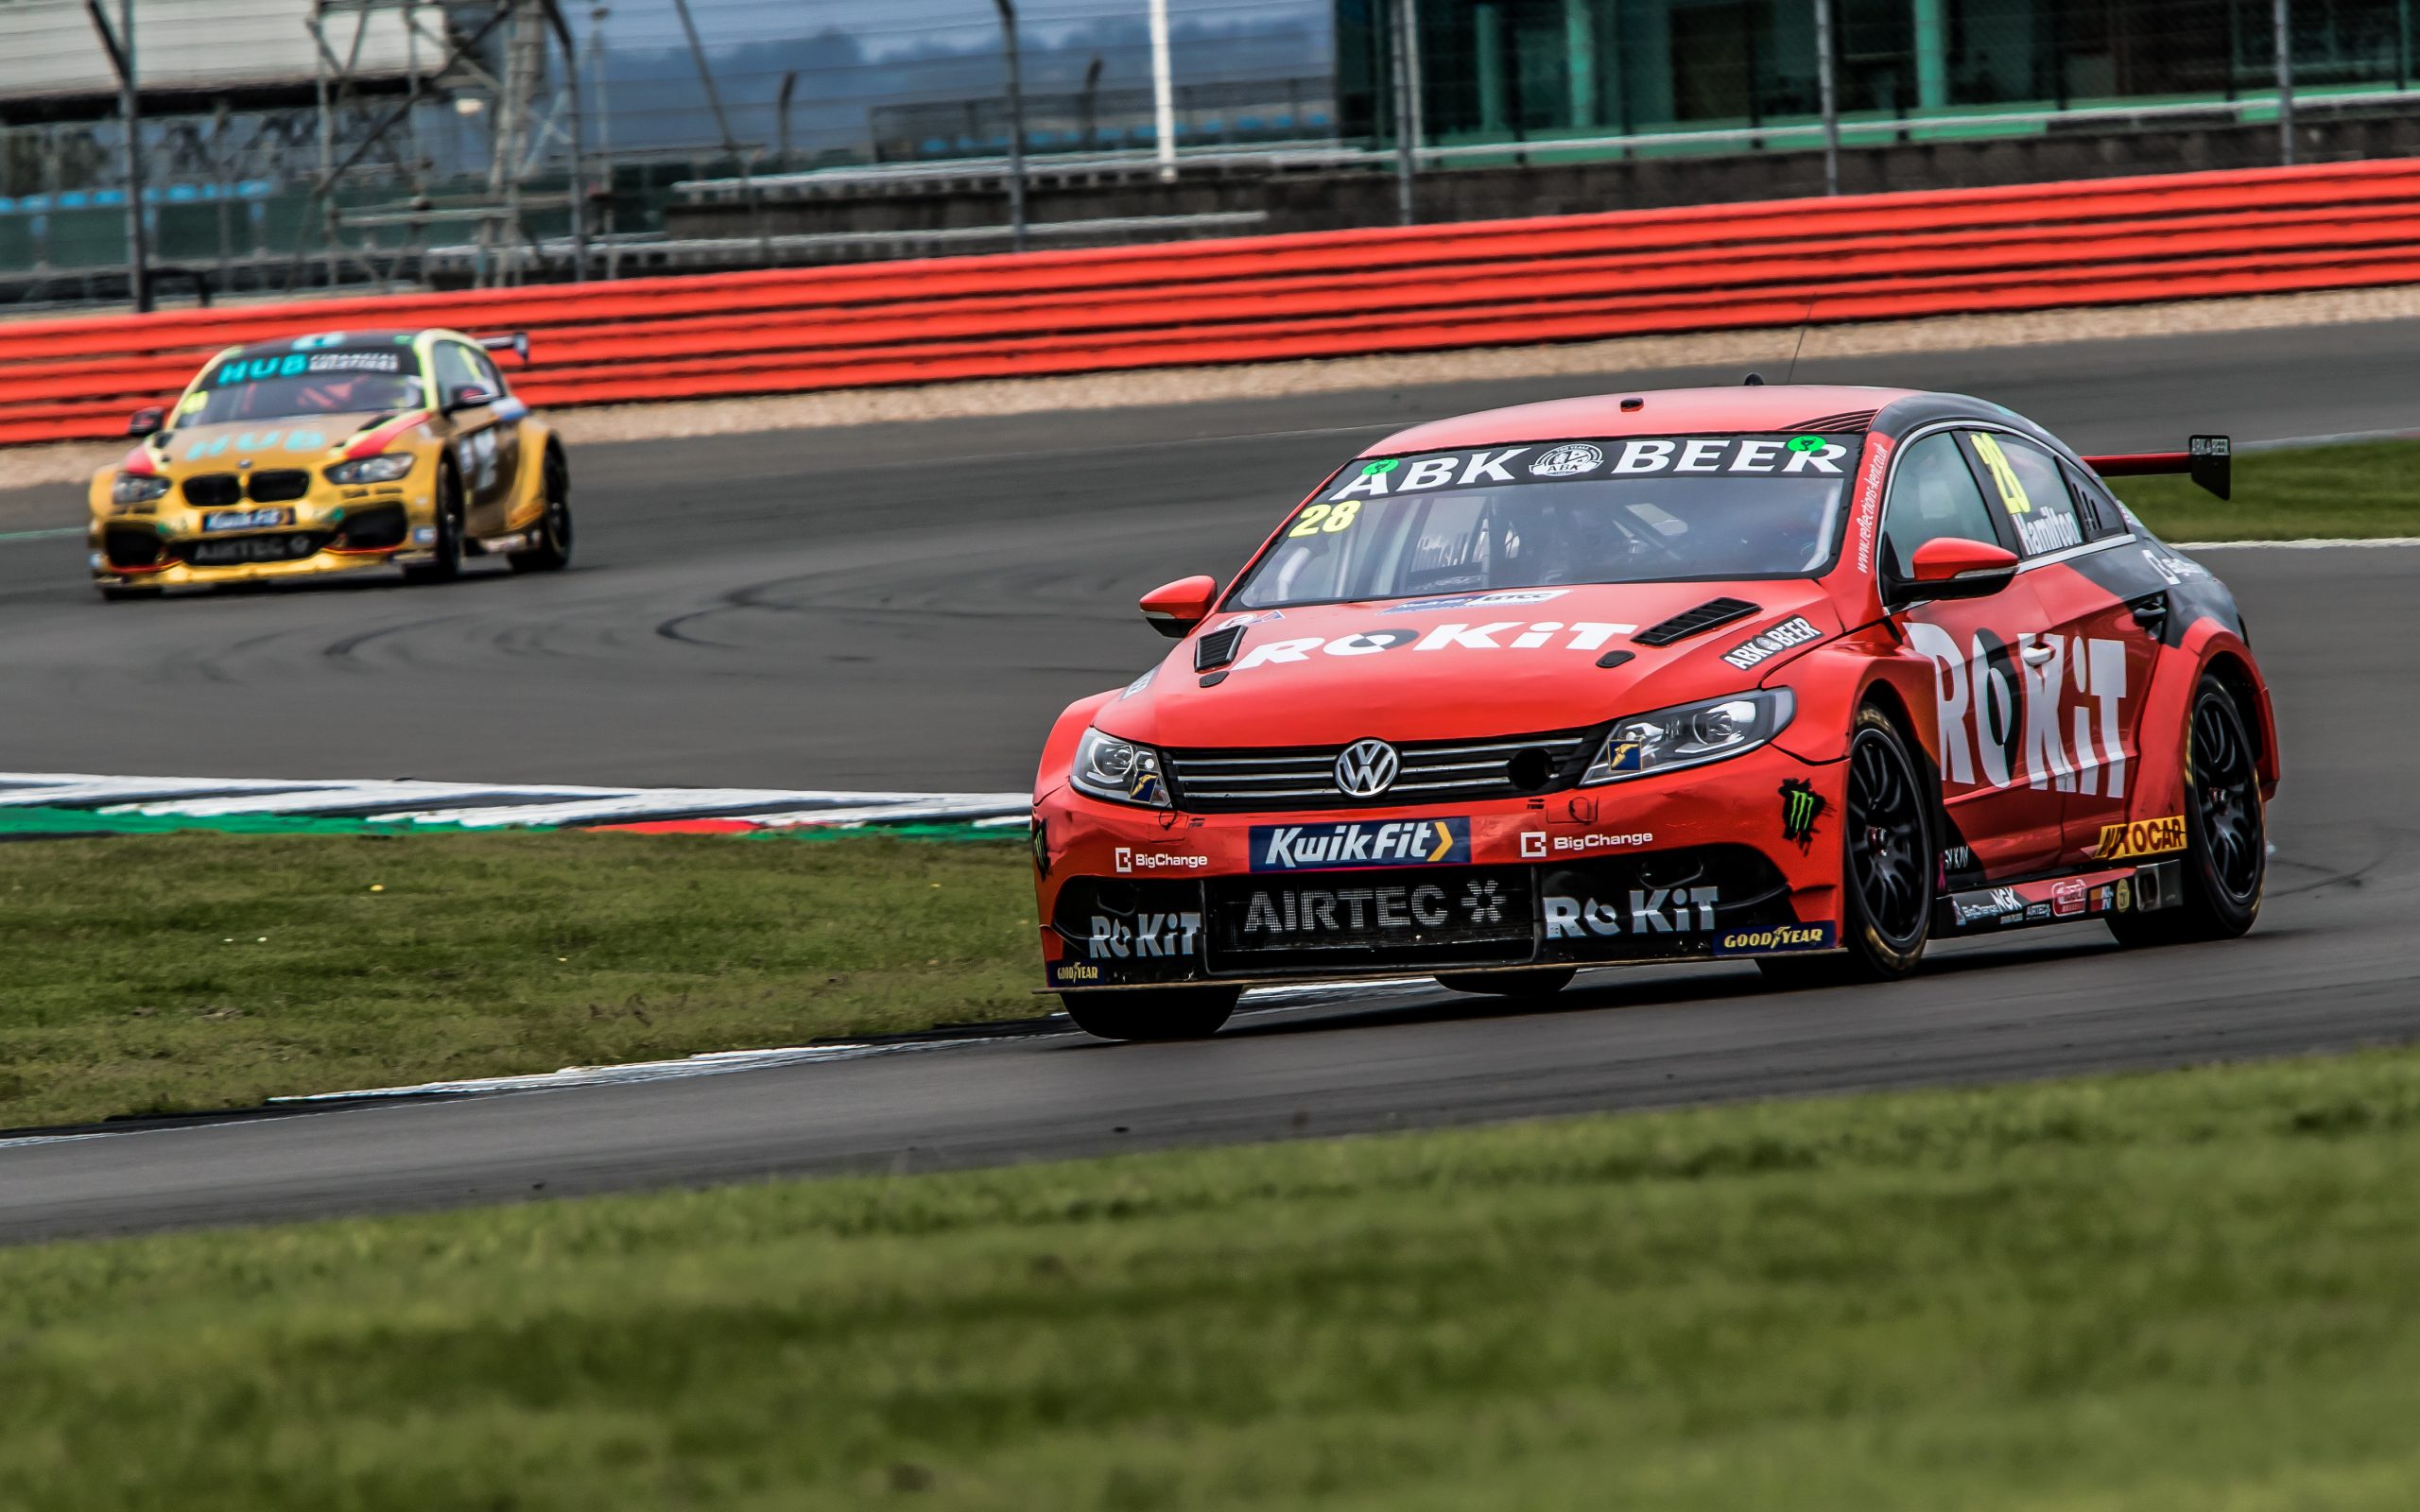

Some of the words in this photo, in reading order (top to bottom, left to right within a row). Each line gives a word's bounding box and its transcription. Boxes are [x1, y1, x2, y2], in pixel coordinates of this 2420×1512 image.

[217, 352, 307, 387] HUB
[184, 429, 324, 461] HUB
[1328, 447, 1532, 502] ABK
[1610, 438, 1847, 474] BEER
[1288, 500, 1362, 539] 28
[2012, 506, 2083, 557] Hamilton
[1723, 642, 1774, 670] ABK
[1765, 617, 1822, 647] BEER
[1135, 852, 1208, 868] BigChange
[1553, 833, 1653, 850] BigChange
[1243, 884, 1449, 934] AIRTEC
[1989, 886, 2023, 914] NGK
